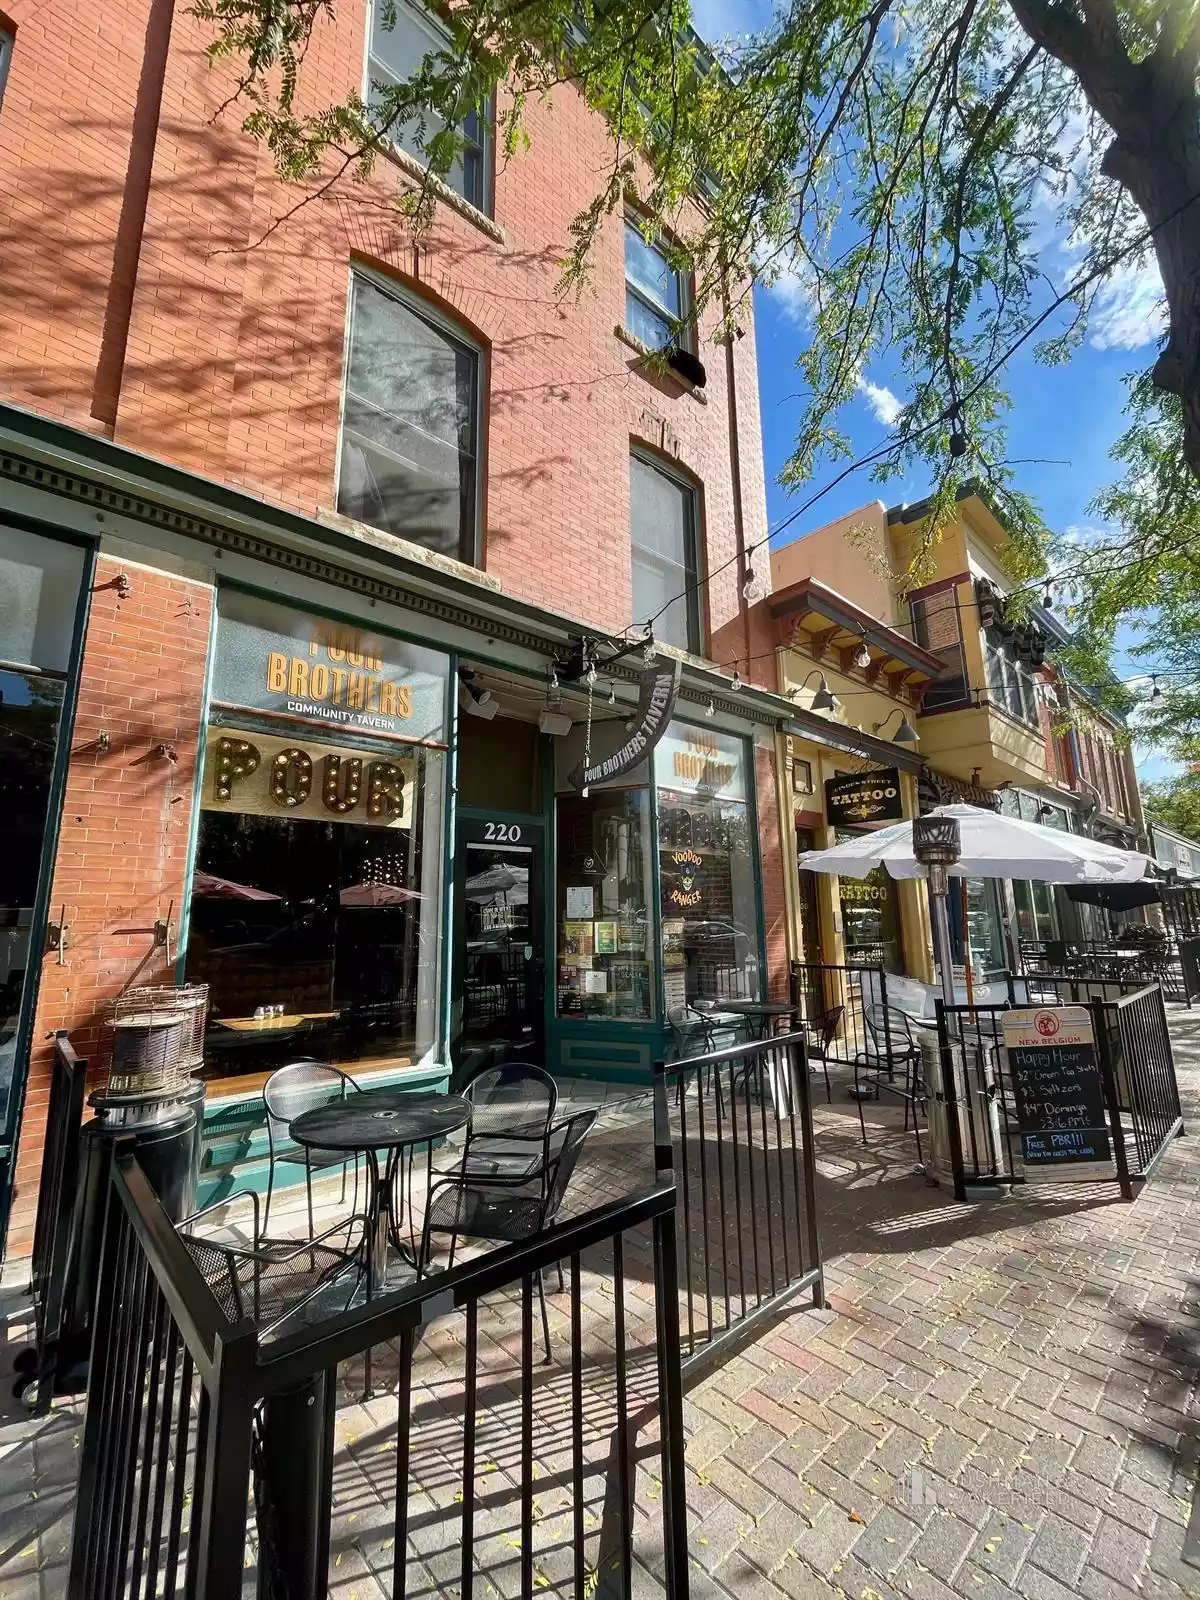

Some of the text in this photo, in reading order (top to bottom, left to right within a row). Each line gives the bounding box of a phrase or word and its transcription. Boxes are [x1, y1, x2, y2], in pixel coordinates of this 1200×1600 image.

[267, 652, 412, 719] BROTHERS
[287, 701, 395, 730] COMMUNITY TAVERN
[584, 674, 673, 782] POUR BROTHERS TAVERN
[213, 737, 405, 818] POUR
[831, 787, 897, 805] TATTOO
[484, 822, 522, 842] 220
[671, 849, 702, 866] VOODOO
[670, 889, 702, 906] RANGER
[1041, 1036, 1081, 1045] BELGIUM
[1016, 1047, 1081, 1067] Happy Hour
[1034, 1069, 1060, 1081] Green
[1020, 1083, 1082, 1097] $3 Seltzers
